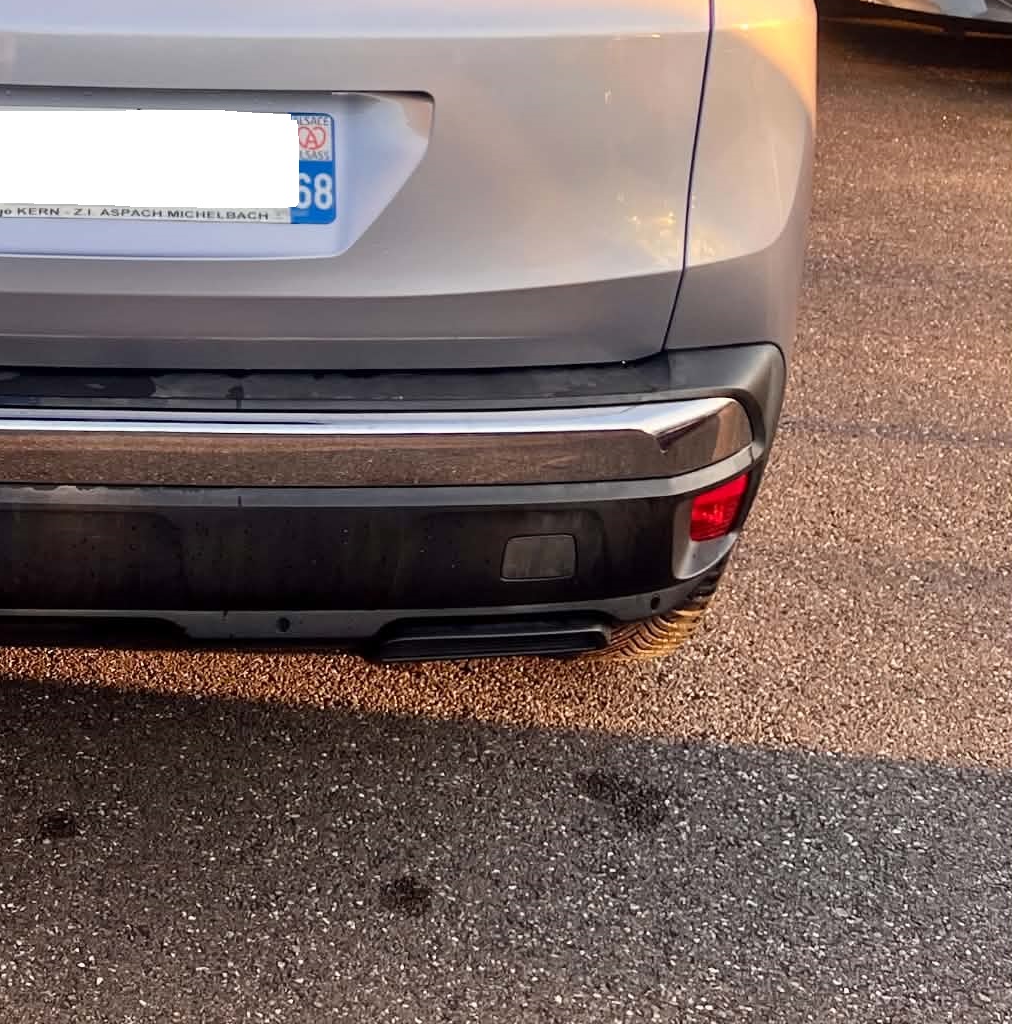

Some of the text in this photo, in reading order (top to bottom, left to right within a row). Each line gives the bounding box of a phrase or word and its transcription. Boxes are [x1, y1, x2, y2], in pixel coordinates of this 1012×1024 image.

[299, 173, 333, 210] 68
[17, 206, 60, 216] KERN
[99, 207, 163, 218] ASPACH
[167, 209, 269, 221] MICHELBACH
